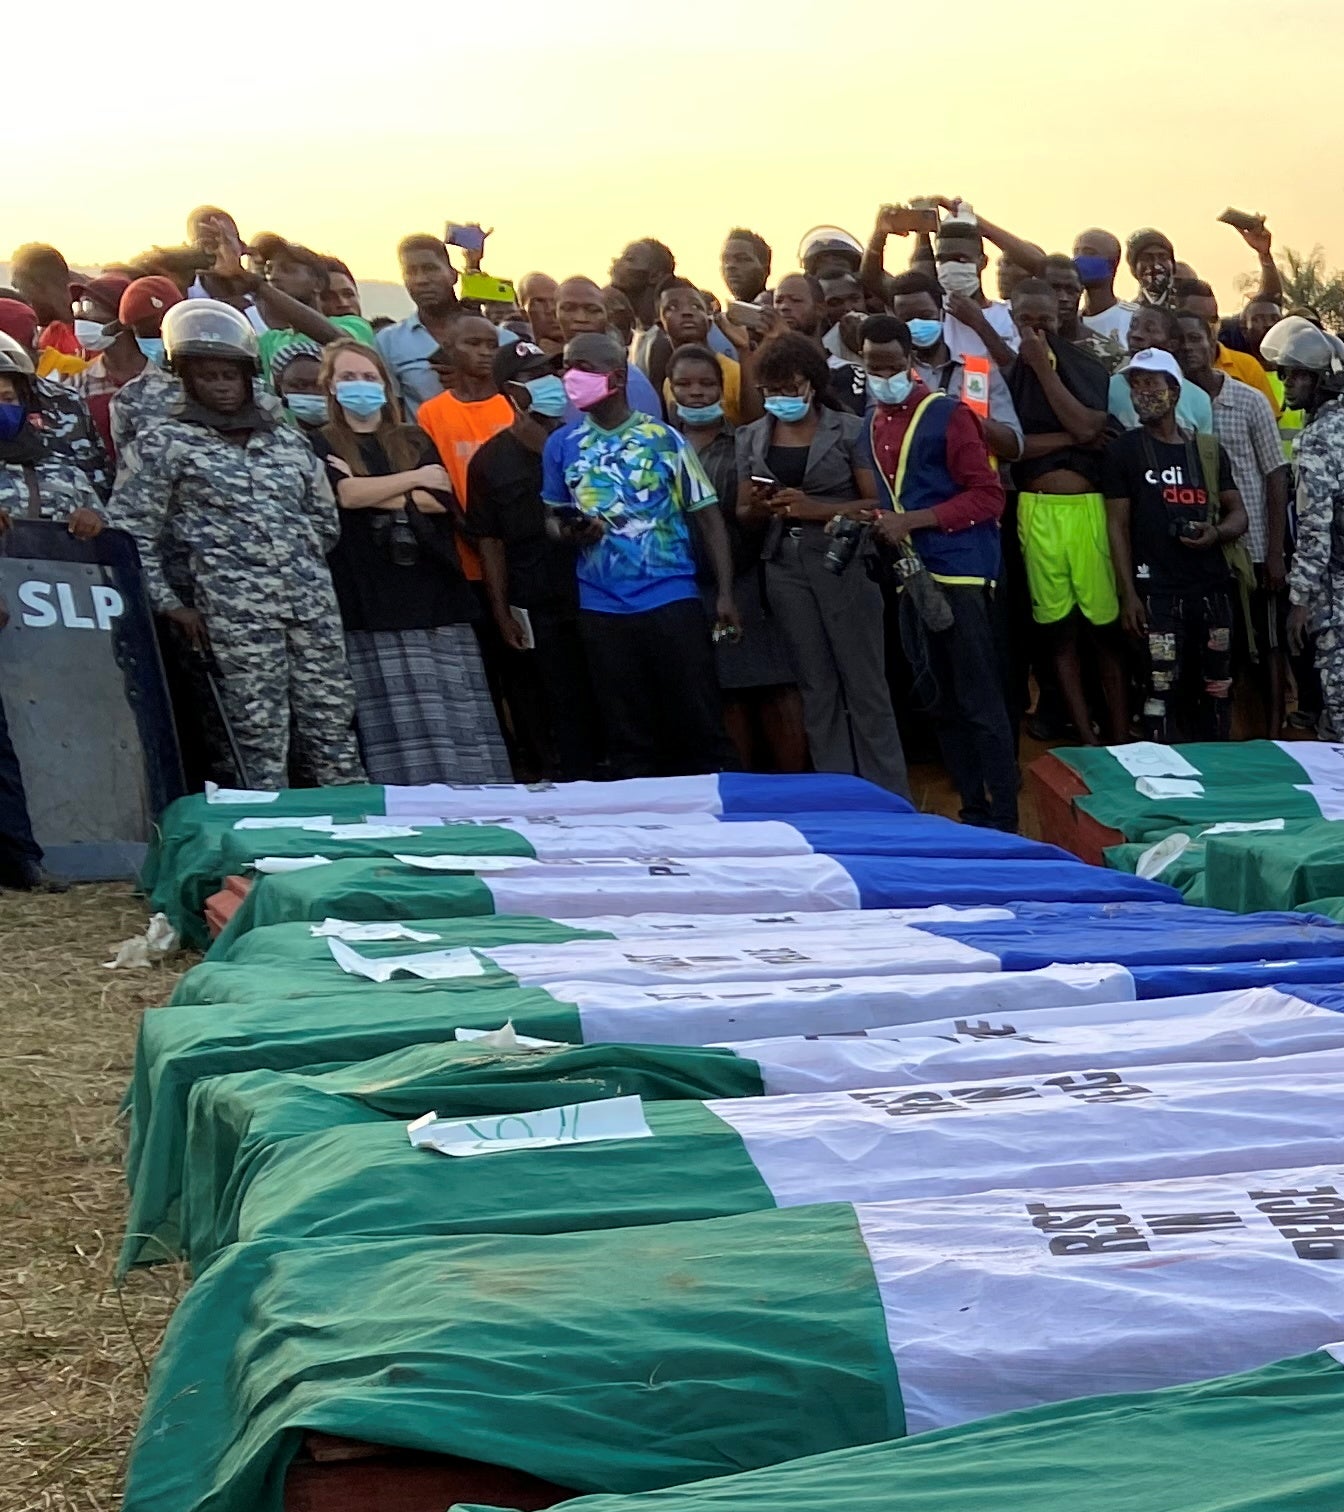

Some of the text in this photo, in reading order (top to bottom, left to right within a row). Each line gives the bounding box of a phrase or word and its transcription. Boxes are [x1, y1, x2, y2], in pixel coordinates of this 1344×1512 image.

[1163, 485, 1207, 504] das
[17, 580, 125, 631] SLP
[1026, 1202, 1152, 1257] REST
[1141, 1211, 1247, 1236] IN
